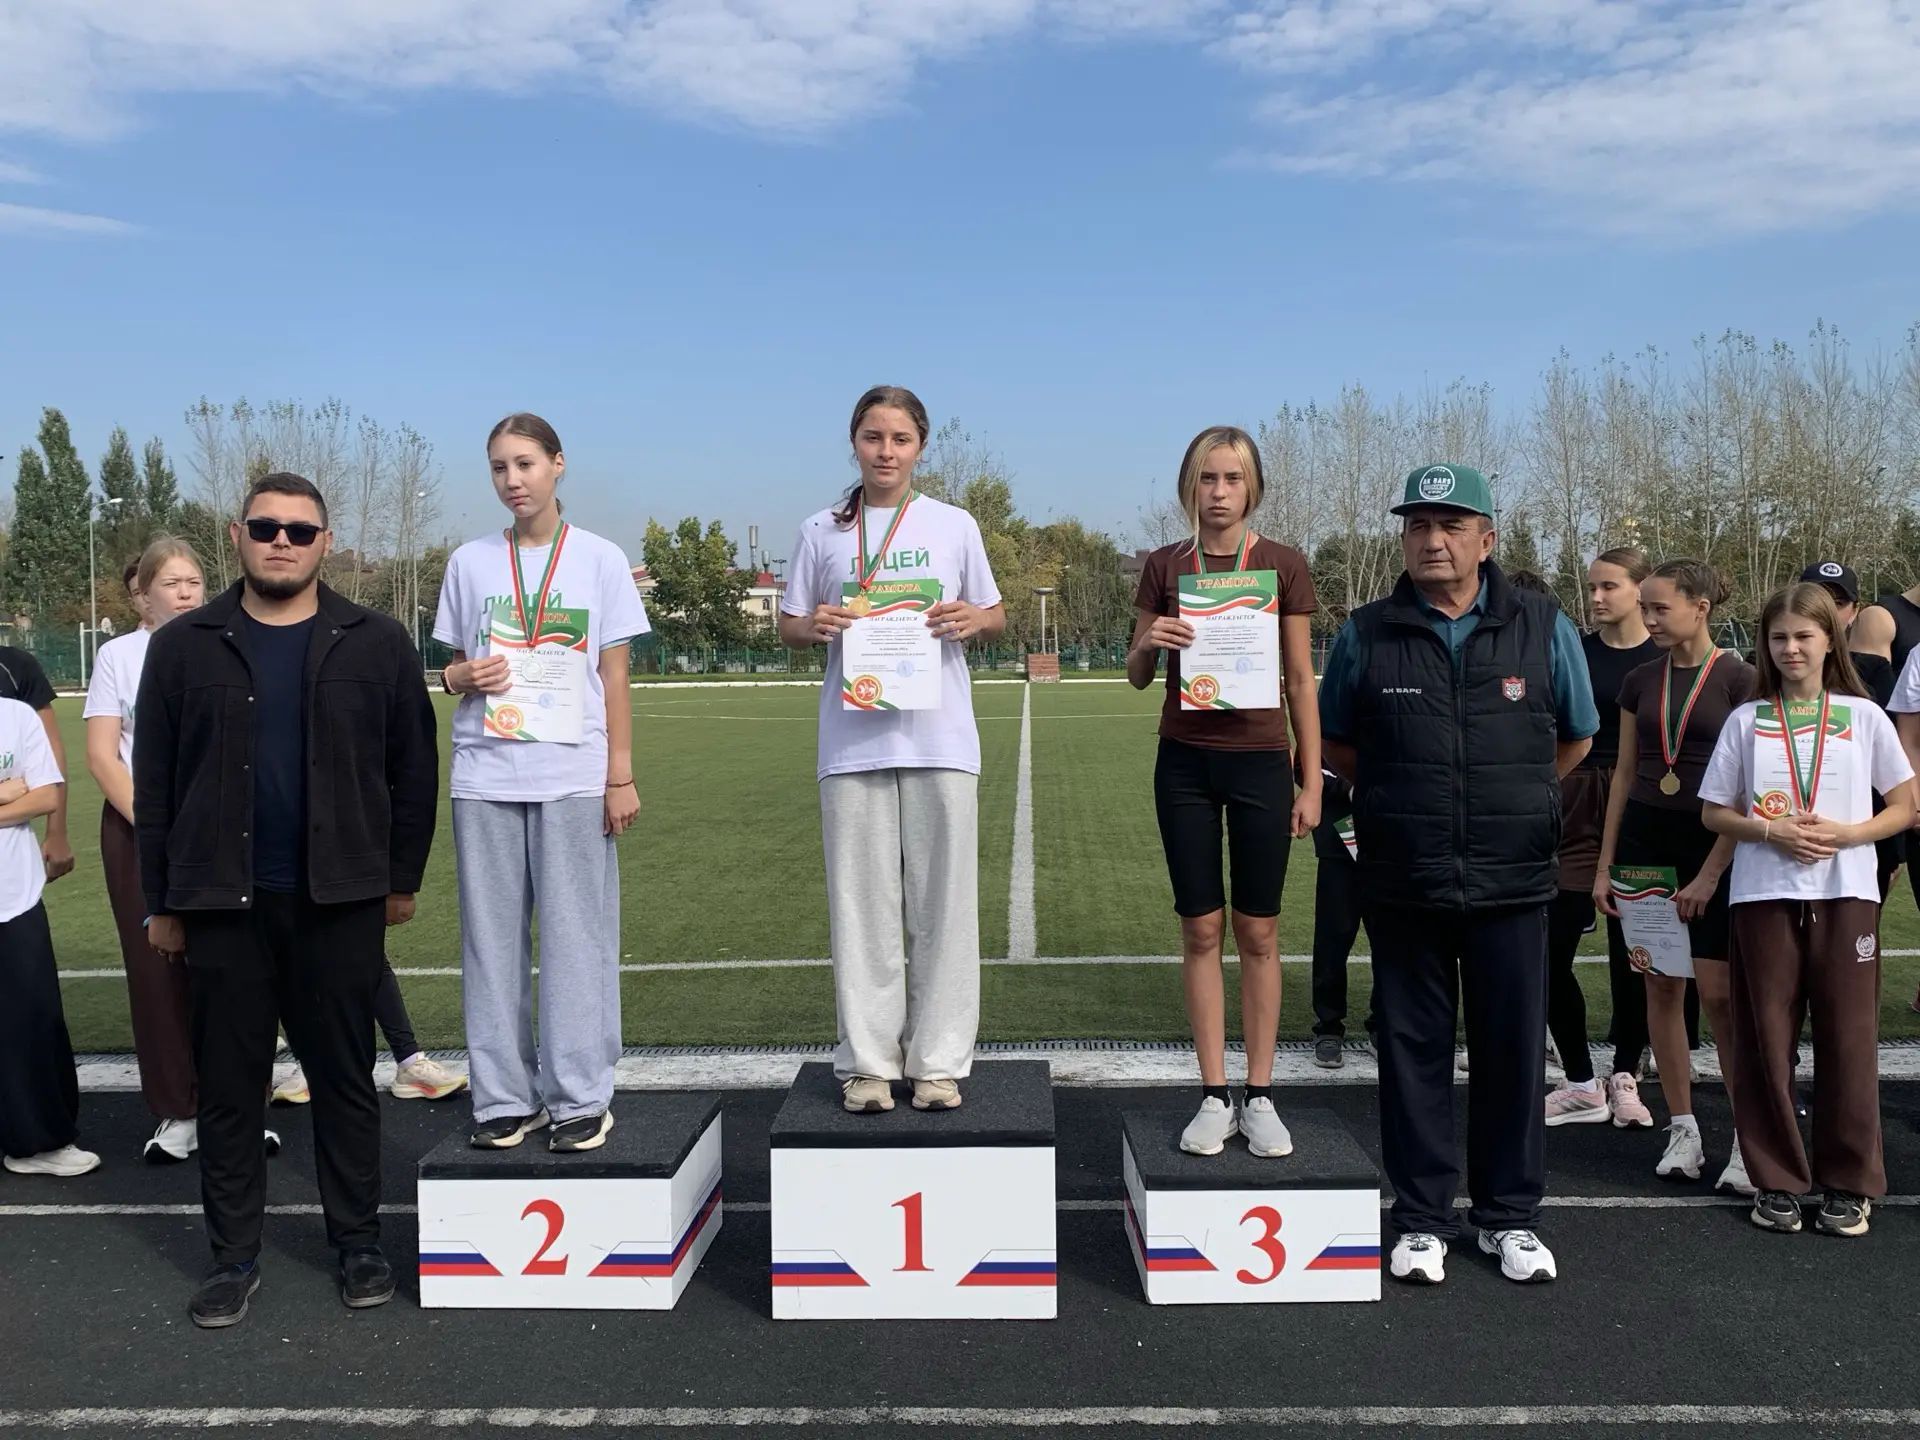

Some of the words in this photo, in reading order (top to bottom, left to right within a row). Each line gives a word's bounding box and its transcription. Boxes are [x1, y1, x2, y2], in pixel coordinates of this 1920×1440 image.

[1196, 576, 1259, 590] ГРАМОТА
[520, 1199, 569, 1275] 2
[891, 1192, 935, 1271] 1
[1236, 1205, 1287, 1285] 3
